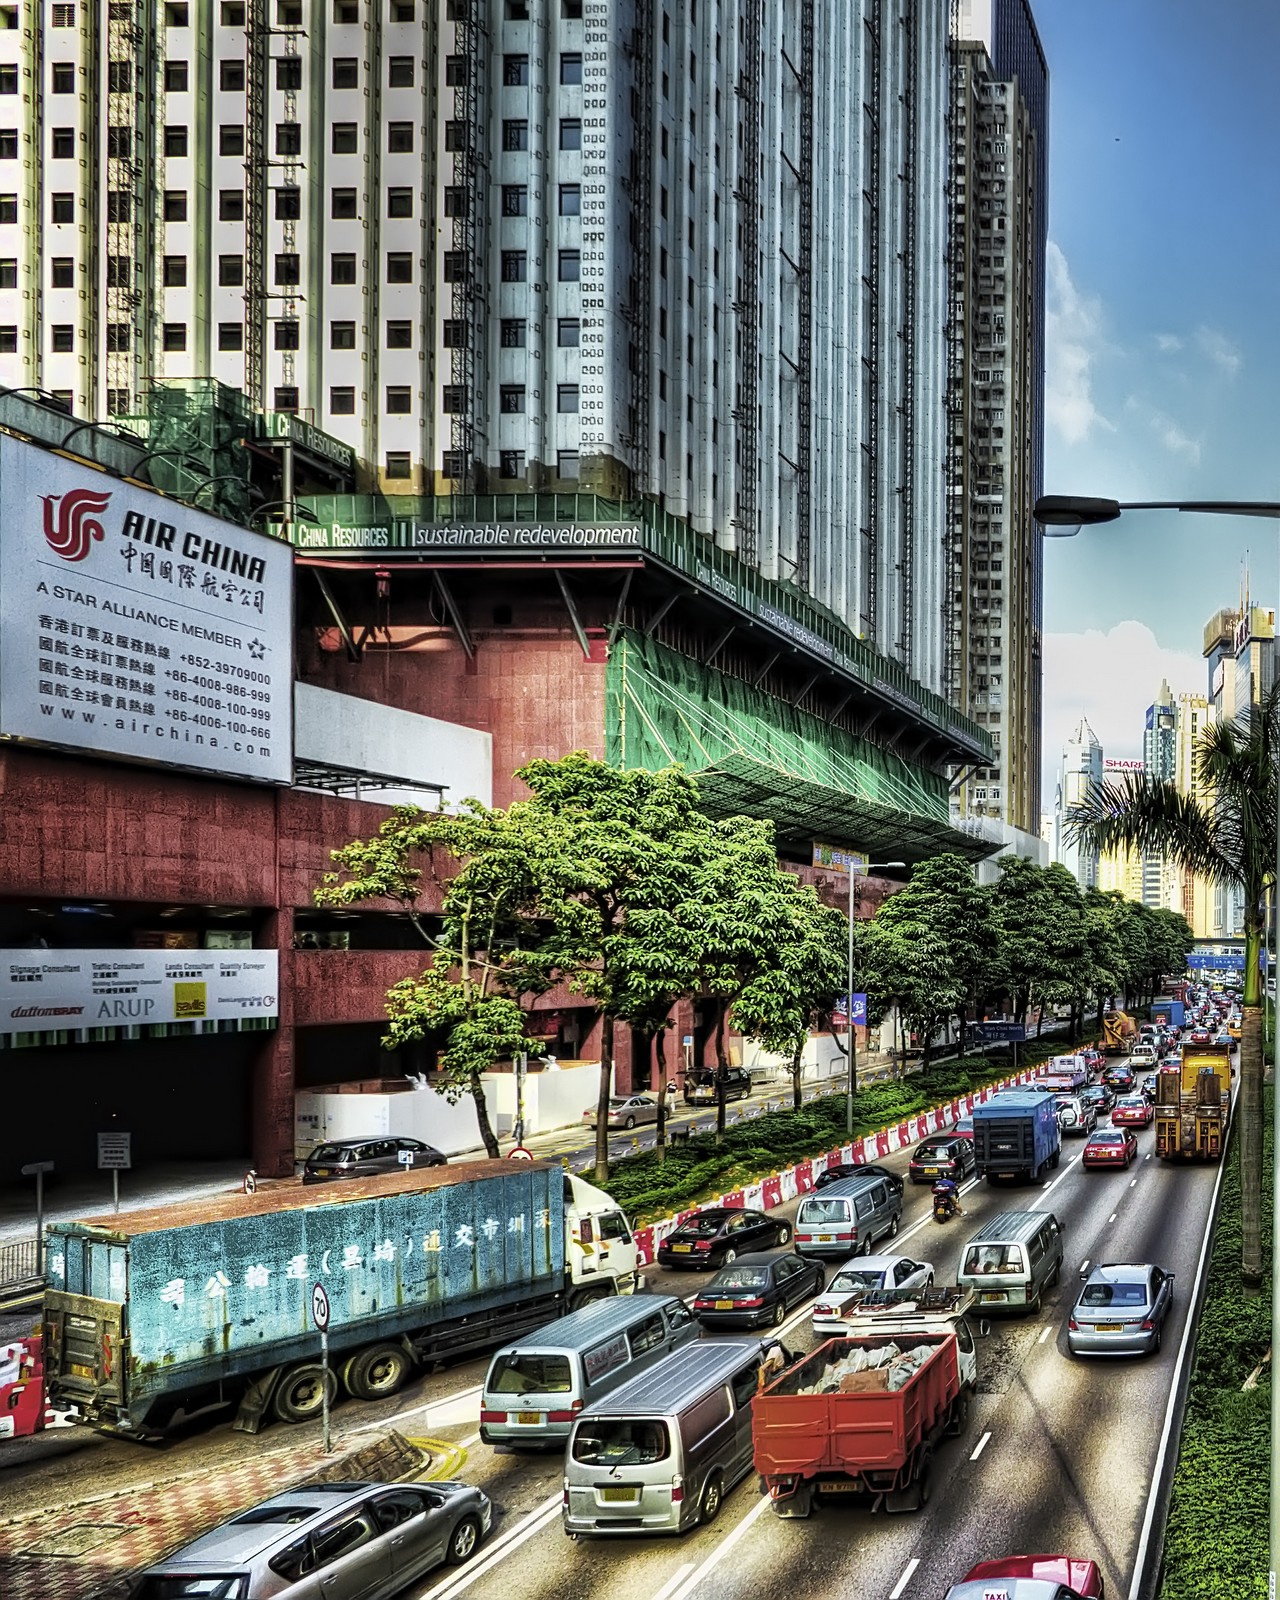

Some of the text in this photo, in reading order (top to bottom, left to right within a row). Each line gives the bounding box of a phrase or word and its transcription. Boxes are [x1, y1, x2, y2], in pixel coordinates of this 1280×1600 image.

[277, 414, 352, 468] CHINA RESOURCES
[122, 510, 267, 584] AIR CHINA
[298, 526, 389, 547] CHINA RESOURCES
[416, 523, 640, 547] sustainable redevelopment
[36, 581, 242, 651] A STAR ALLIANCE MEMBER
[38, 613, 271, 686] 香港訂票及服務熱線 +852-39709000
[38, 636, 271, 704] 國航全球訂票熱線 +86-4008-986-999
[38, 657, 271, 722] 國航全球服務熱線 +86-4008-100-999
[38, 680, 271, 740] 國航全球會員熱線 +86-4006-100-666
[40, 703, 271, 758] www.airchina.com
[1105, 759, 1145, 769] SHARP
[9, 964, 80, 974] Signage Consultant
[113, 962, 145, 970] Consultant
[97, 998, 155, 1018] ARUP
[176, 999, 206, 1012] savills
[315, 1296, 326, 1317] 70
